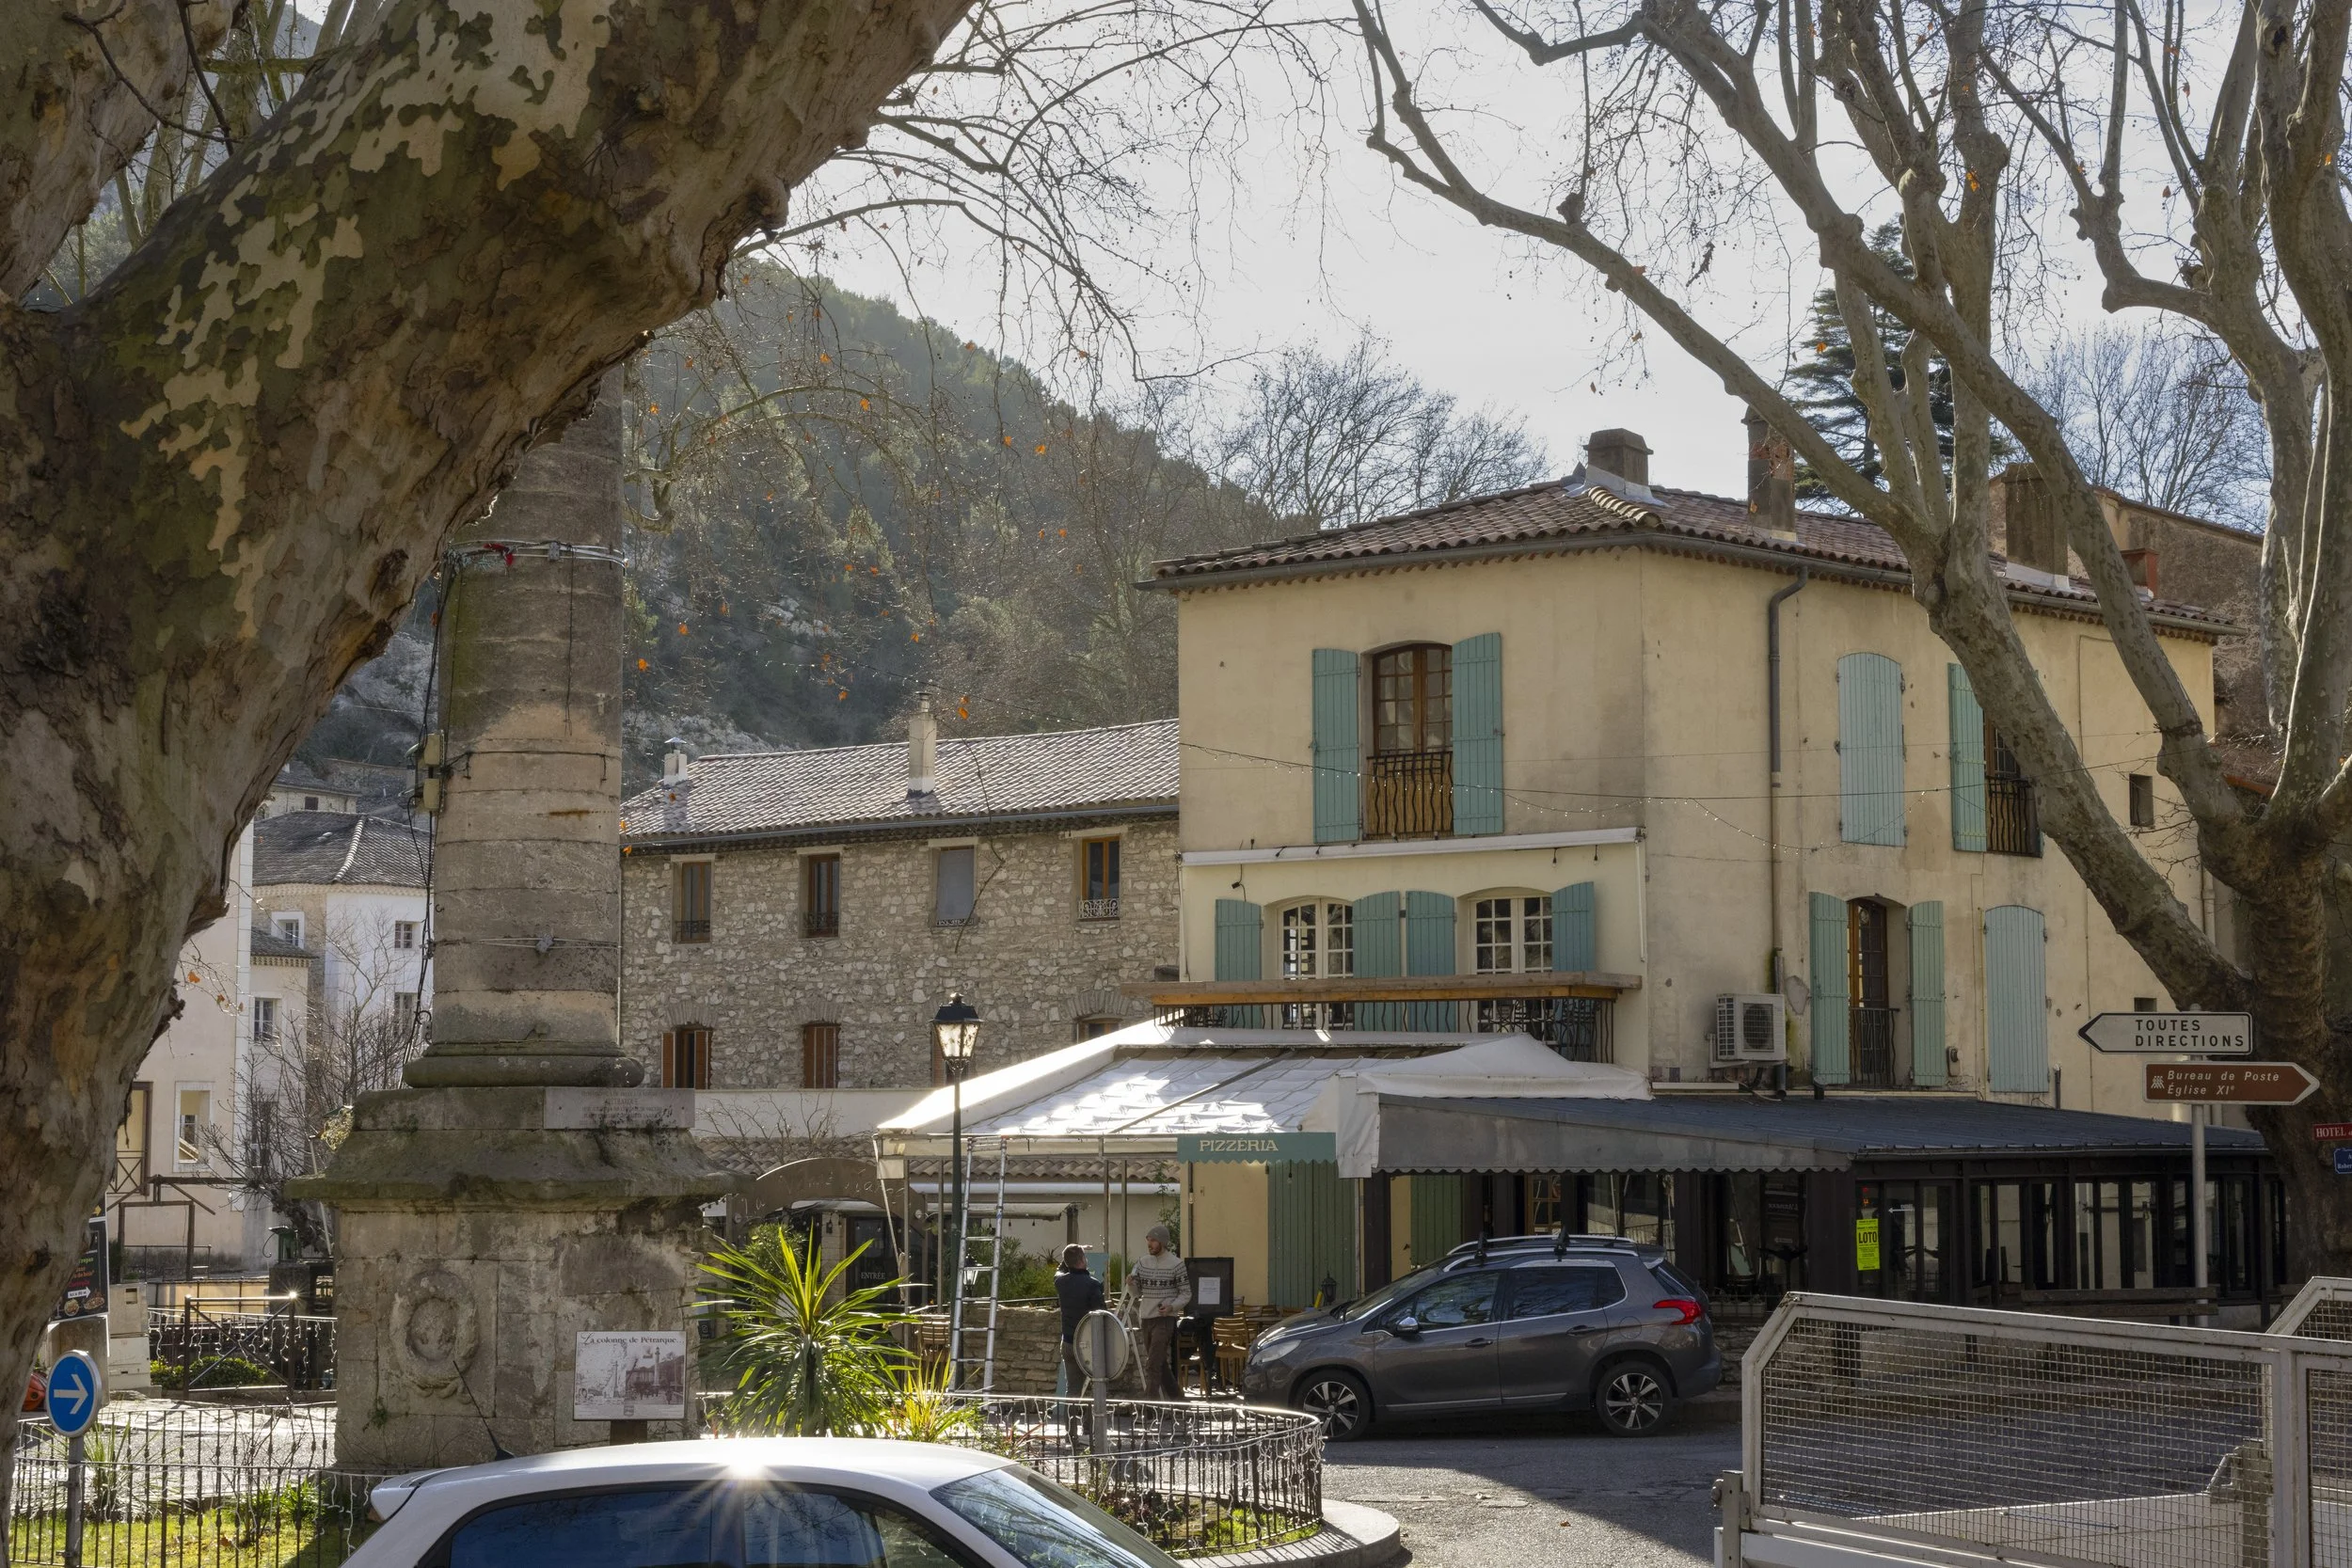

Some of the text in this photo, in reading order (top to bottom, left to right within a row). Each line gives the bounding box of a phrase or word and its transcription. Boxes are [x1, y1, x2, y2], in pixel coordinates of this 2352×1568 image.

[2136, 1020, 2201, 1031] TOUTES
[2136, 1036, 2244, 1046] DIRECTIONS
[2168, 1070, 2212, 1080] Bureau
[2221, 1071, 2235, 1080] de
[2168, 1082, 2207, 1097] Église
[2316, 1127, 2346, 1137] HOTEL
[1200, 1137, 1279, 1152] PIZZÉRIA
[1858, 1231, 1878, 1243] LOTO
[580, 1332, 595, 1345] La
